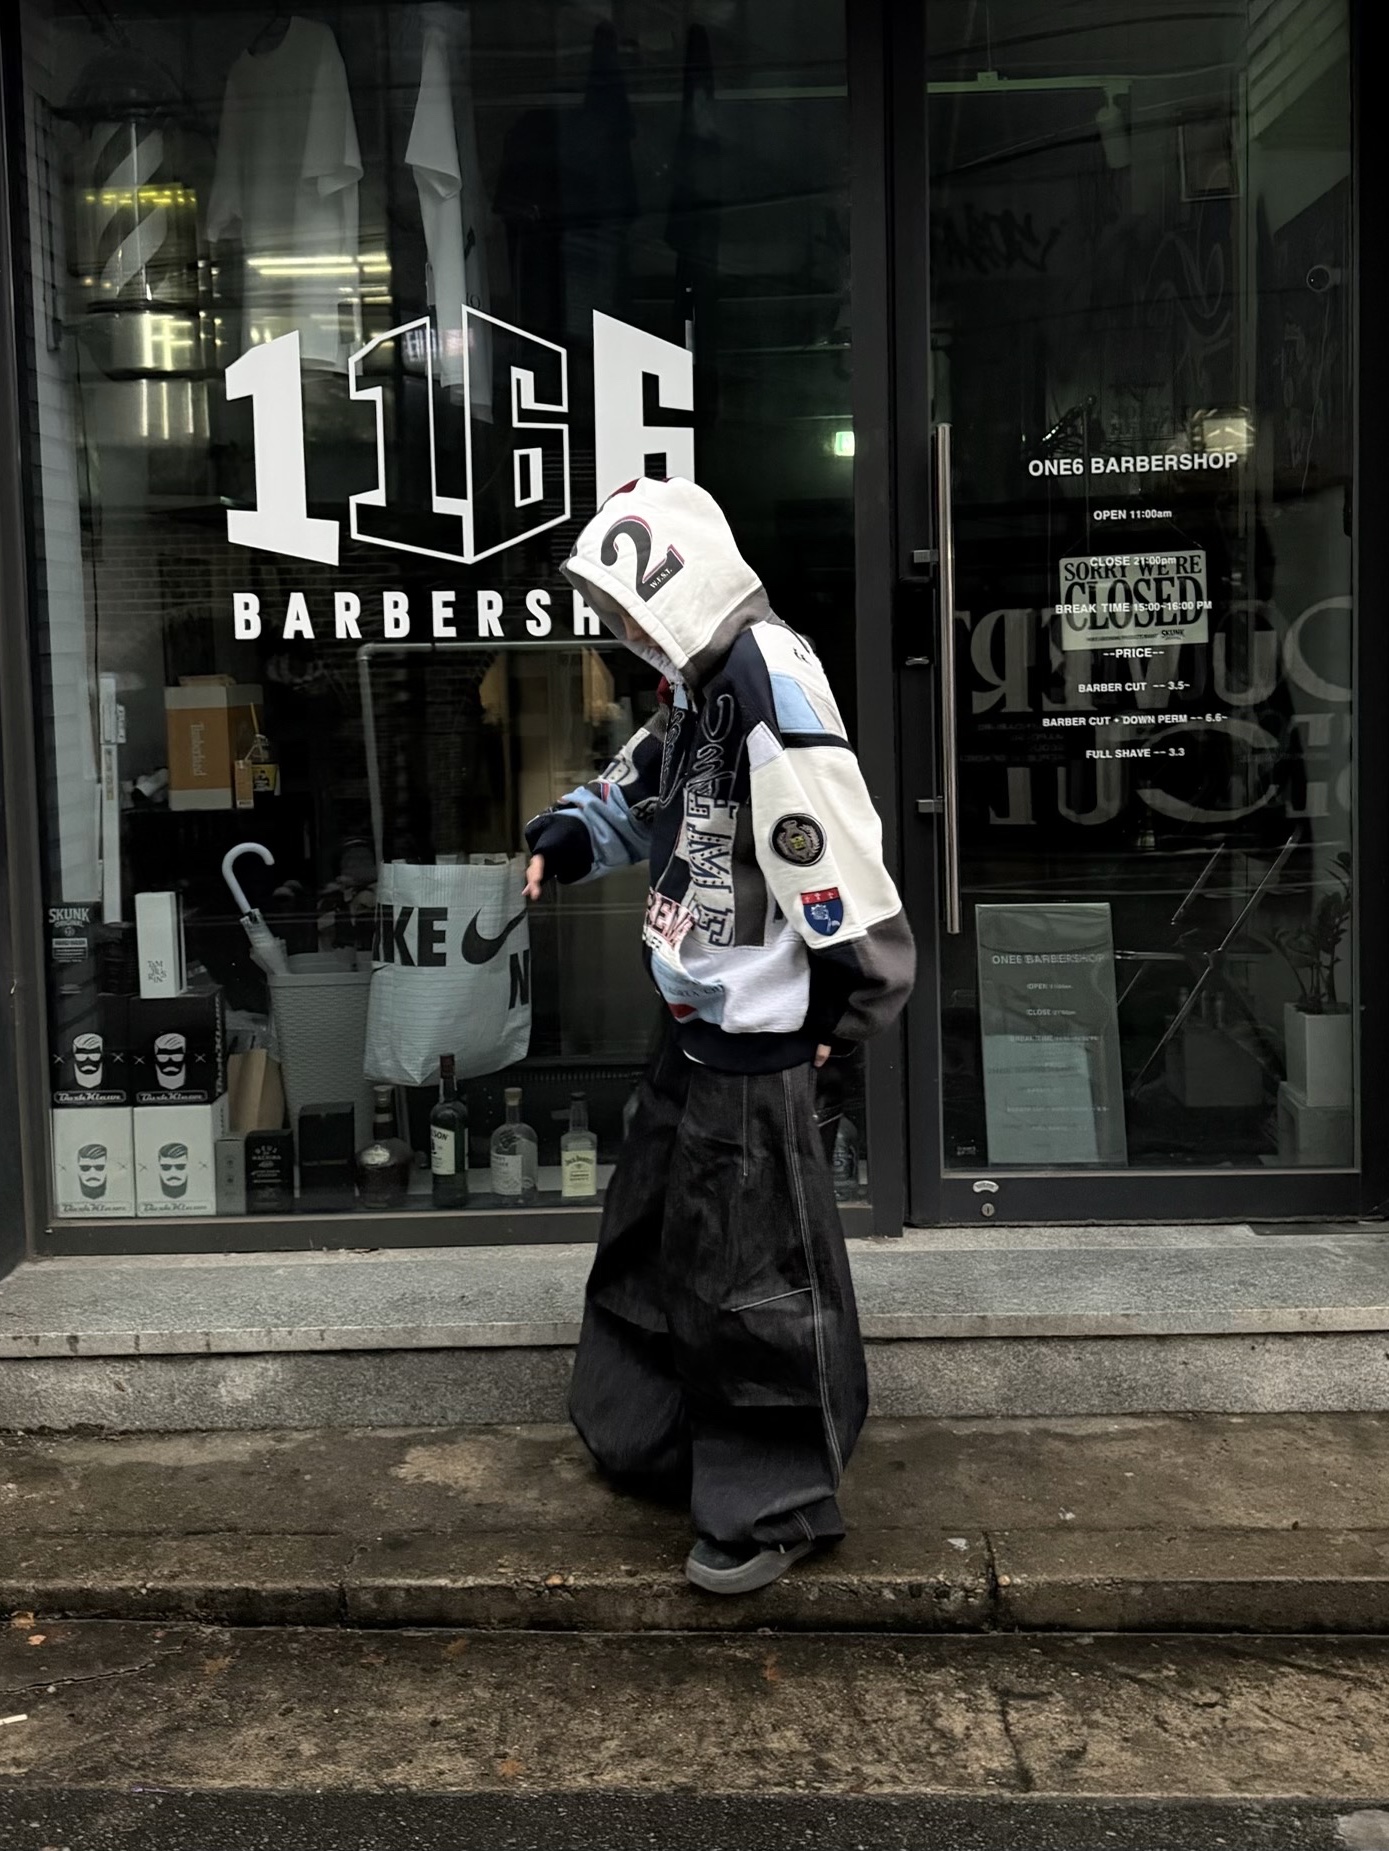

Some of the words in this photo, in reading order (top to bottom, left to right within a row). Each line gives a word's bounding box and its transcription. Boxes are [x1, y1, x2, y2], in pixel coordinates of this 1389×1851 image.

[1028, 458, 1084, 477] ONE6
[1090, 452, 1238, 474] BARBERSHOP
[1093, 510, 1127, 521] OPEN
[1129, 509, 1172, 519] 11:00am
[601, 515, 684, 602] 2
[1089, 556, 1130, 567] CLOSE
[1064, 557, 1127, 581] SORRY
[1055, 603, 1097, 614] BREAK
[1101, 602, 1130, 613] TIME
[1197, 600, 1212, 610] PM
[1066, 575, 1204, 632] CLOSED
[1078, 682, 1123, 693] BARBER
[1124, 681, 1148, 692] CUT
[1042, 717, 1087, 728] BARBER
[1088, 716, 1111, 727] CUT
[1122, 715, 1156, 726] DOWN
[1157, 714, 1188, 725] PERM
[1085, 749, 1113, 760] FULL
[1114, 748, 1151, 759] SHAVE
[1168, 747, 1185, 758] 3.3
[49, 908, 91, 923] SKUNK
